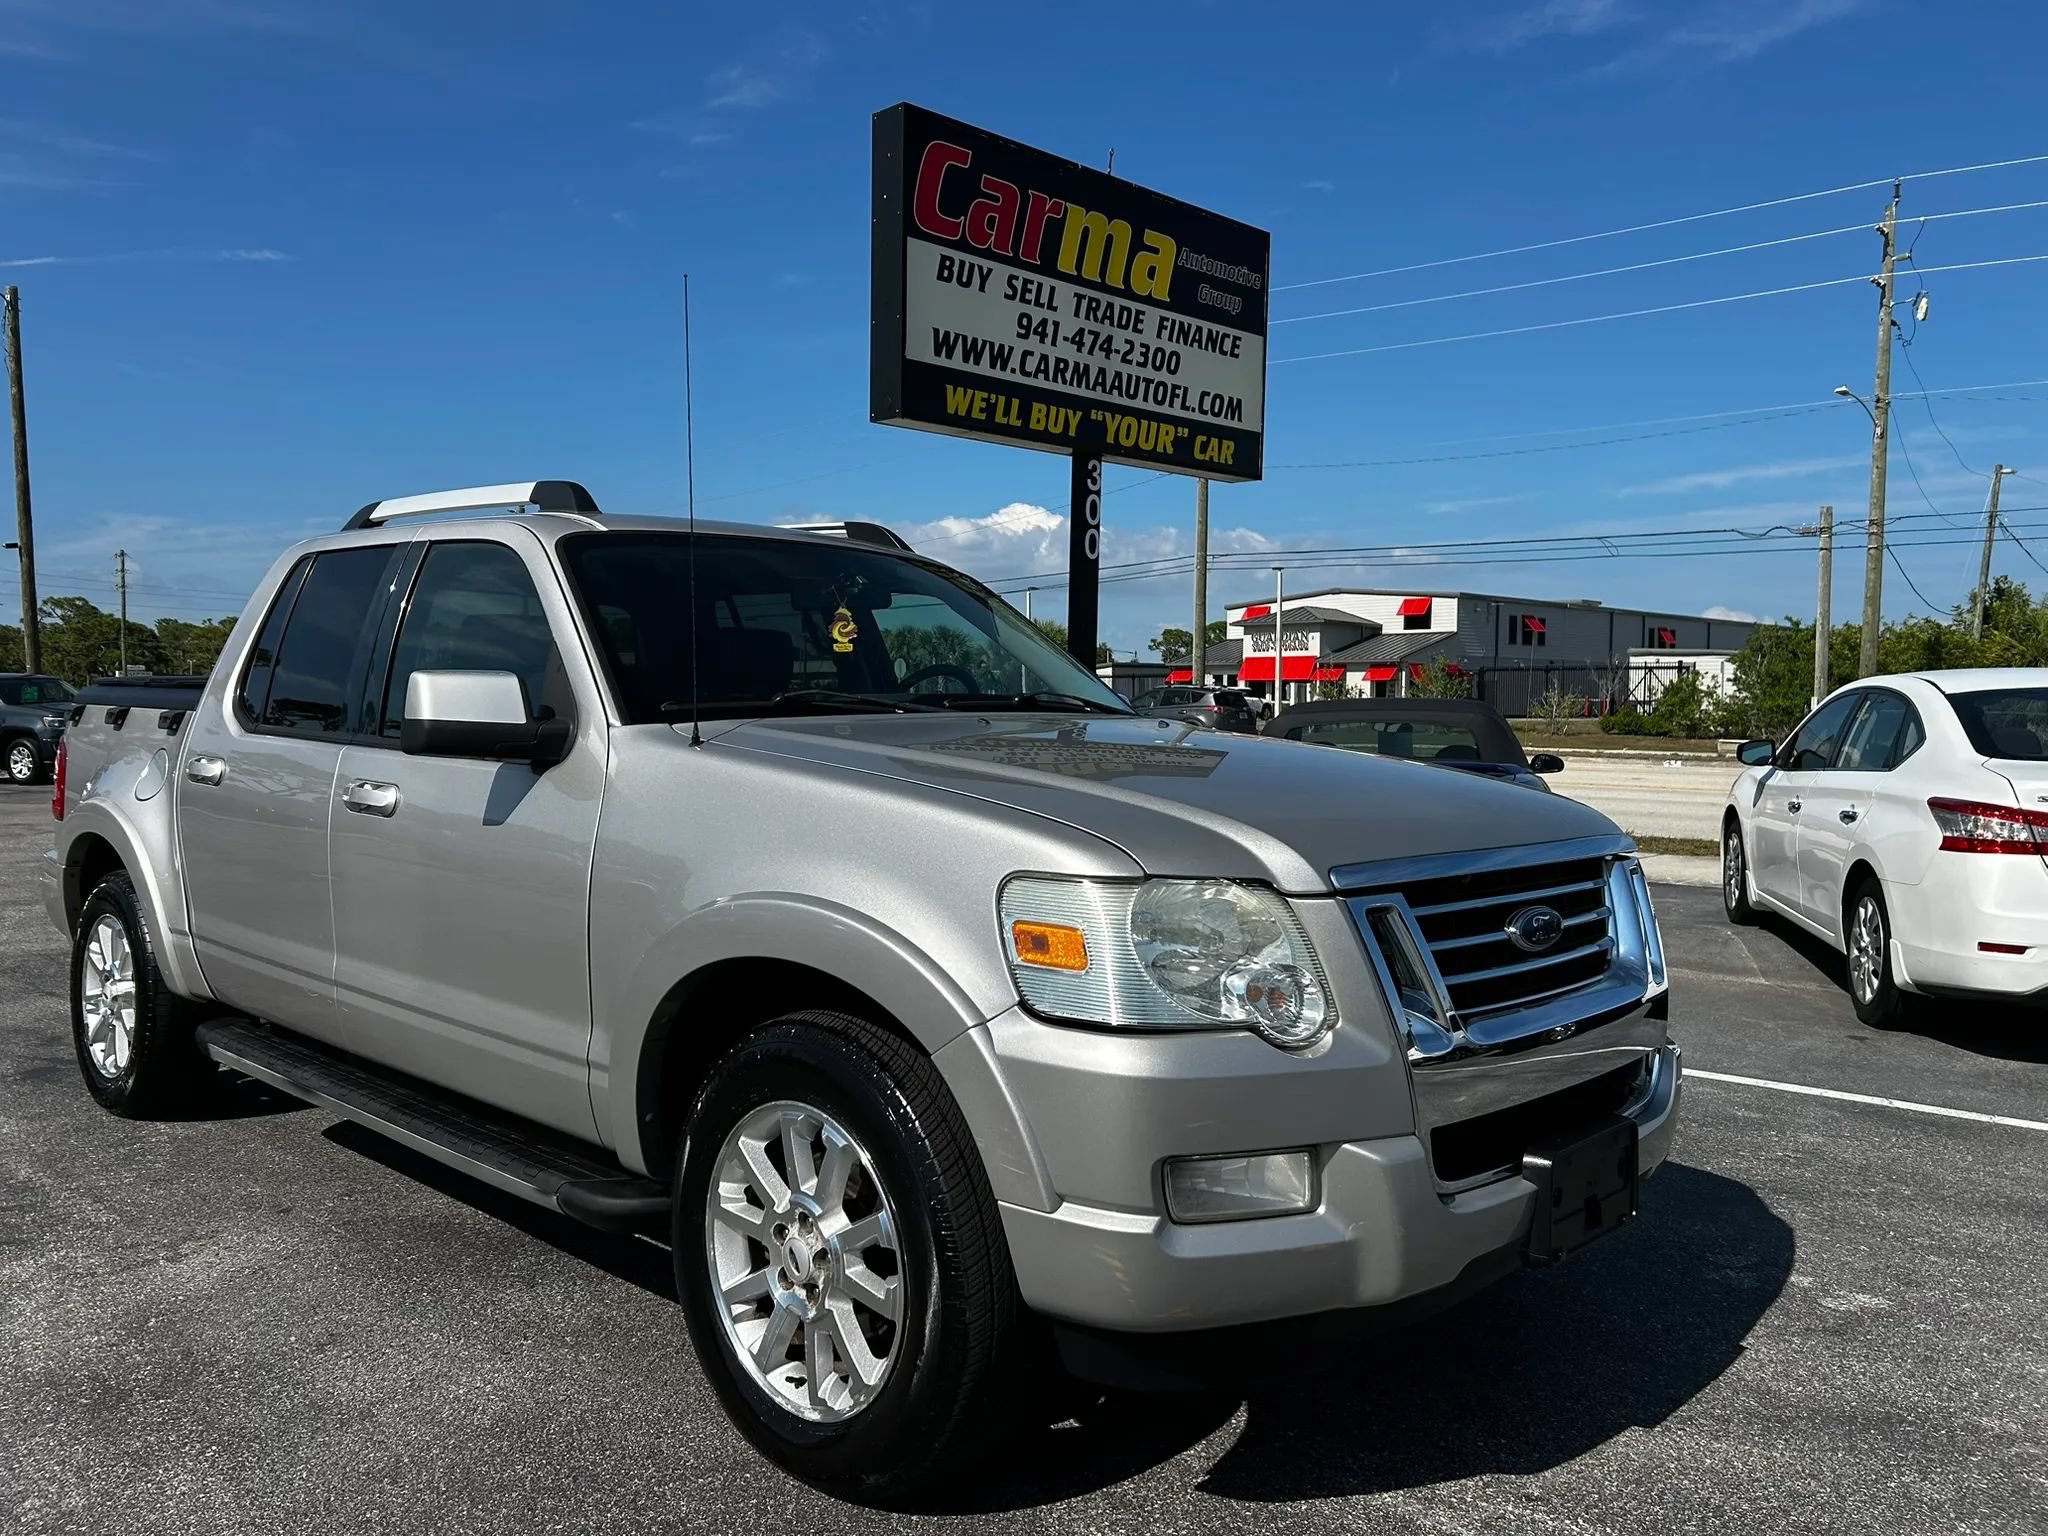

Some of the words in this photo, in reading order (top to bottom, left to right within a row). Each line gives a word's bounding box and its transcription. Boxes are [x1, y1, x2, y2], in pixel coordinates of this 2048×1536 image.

[914, 141, 1177, 302] Carma
[936, 253, 993, 293] BUY
[1004, 273, 1058, 312] SELL
[1073, 292, 1146, 334] TRADE
[1156, 315, 1242, 359] FINANCE
[1178, 247, 1261, 289] Automotive
[1198, 284, 1242, 315] Group
[932, 327, 1243, 423] WWW.CARMAAUTOFL.COM
[1016, 312, 1181, 375] 941-474-2300
[945, 384, 1022, 427] WE'LL
[1029, 401, 1083, 437] BUY
[1090, 409, 1189, 454] "YOUR"
[1193, 435, 1235, 465] CAR
[1085, 459, 1100, 559] 300
[1251, 631, 1309, 642] GUADIAN
